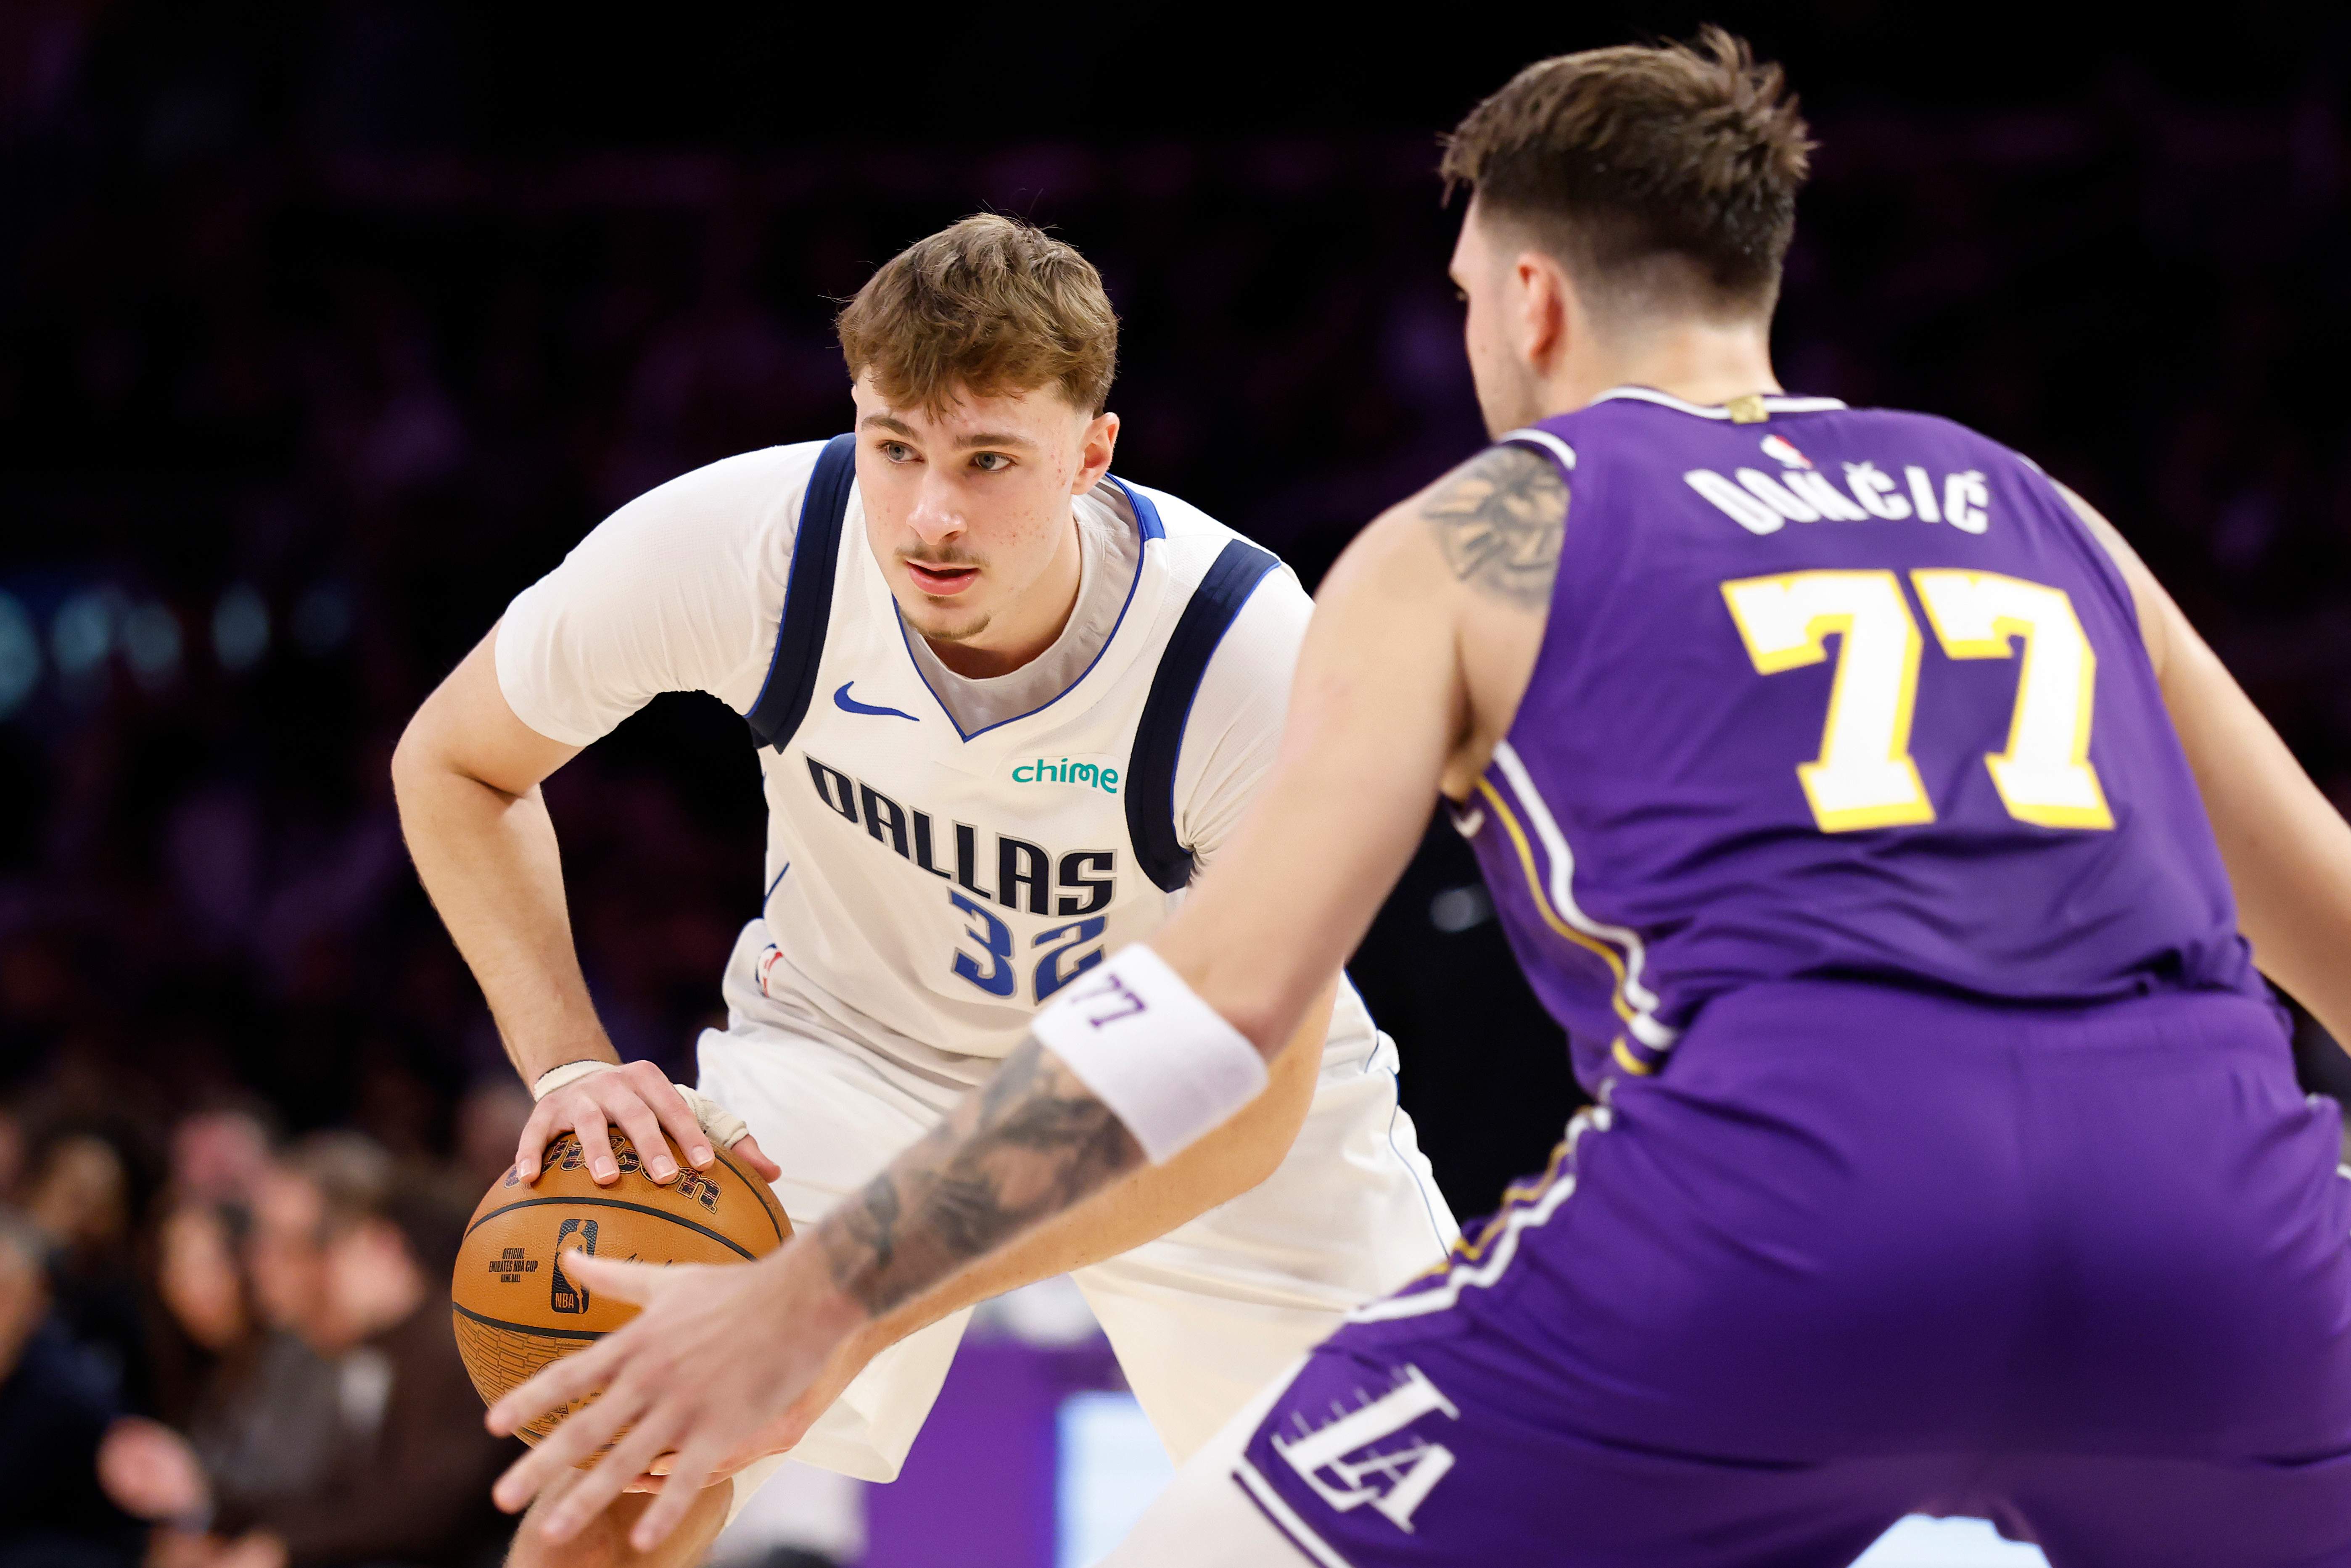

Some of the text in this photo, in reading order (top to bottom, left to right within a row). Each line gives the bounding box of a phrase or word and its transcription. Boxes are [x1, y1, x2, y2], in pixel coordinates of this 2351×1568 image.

[1719, 568, 2116, 834] 77
[1012, 758, 1120, 794] chime
[802, 751, 1118, 918] DALLAS
[947, 886, 1109, 1006] 32
[1070, 972, 1148, 1029] 77
[489, 1260, 538, 1272] EMIRATES NBA CUP
[502, 1248, 525, 1259] OFFICIAL
[555, 1293, 574, 1309] NBA
[1270, 1361, 1461, 1535] LA
